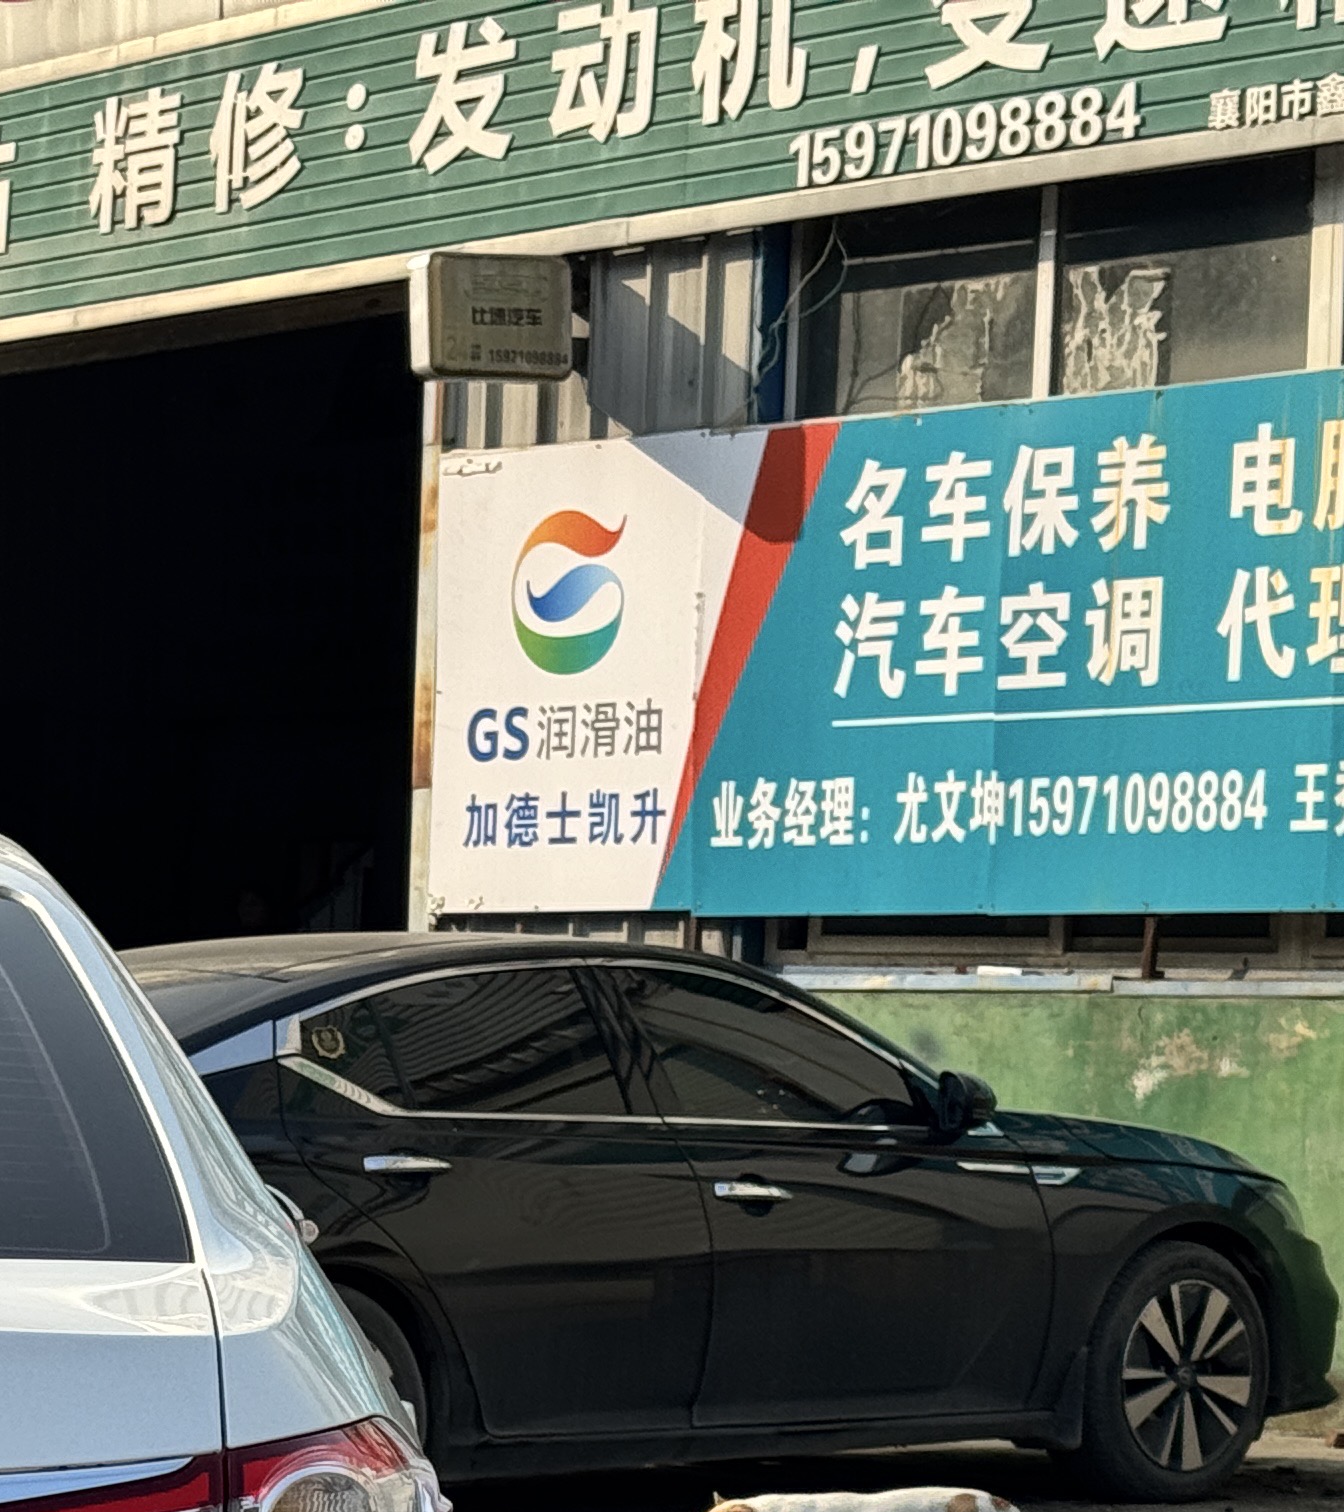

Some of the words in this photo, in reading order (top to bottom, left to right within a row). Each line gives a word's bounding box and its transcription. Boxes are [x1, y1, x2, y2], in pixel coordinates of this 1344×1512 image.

[789, 82, 1141, 187] 15971098884
[840, 433, 1170, 570] 名车保养
[832, 576, 1164, 699] 汽车空调
[463, 788, 667, 849] 加德士凯升
[1290, 760, 1344, 838] 王
